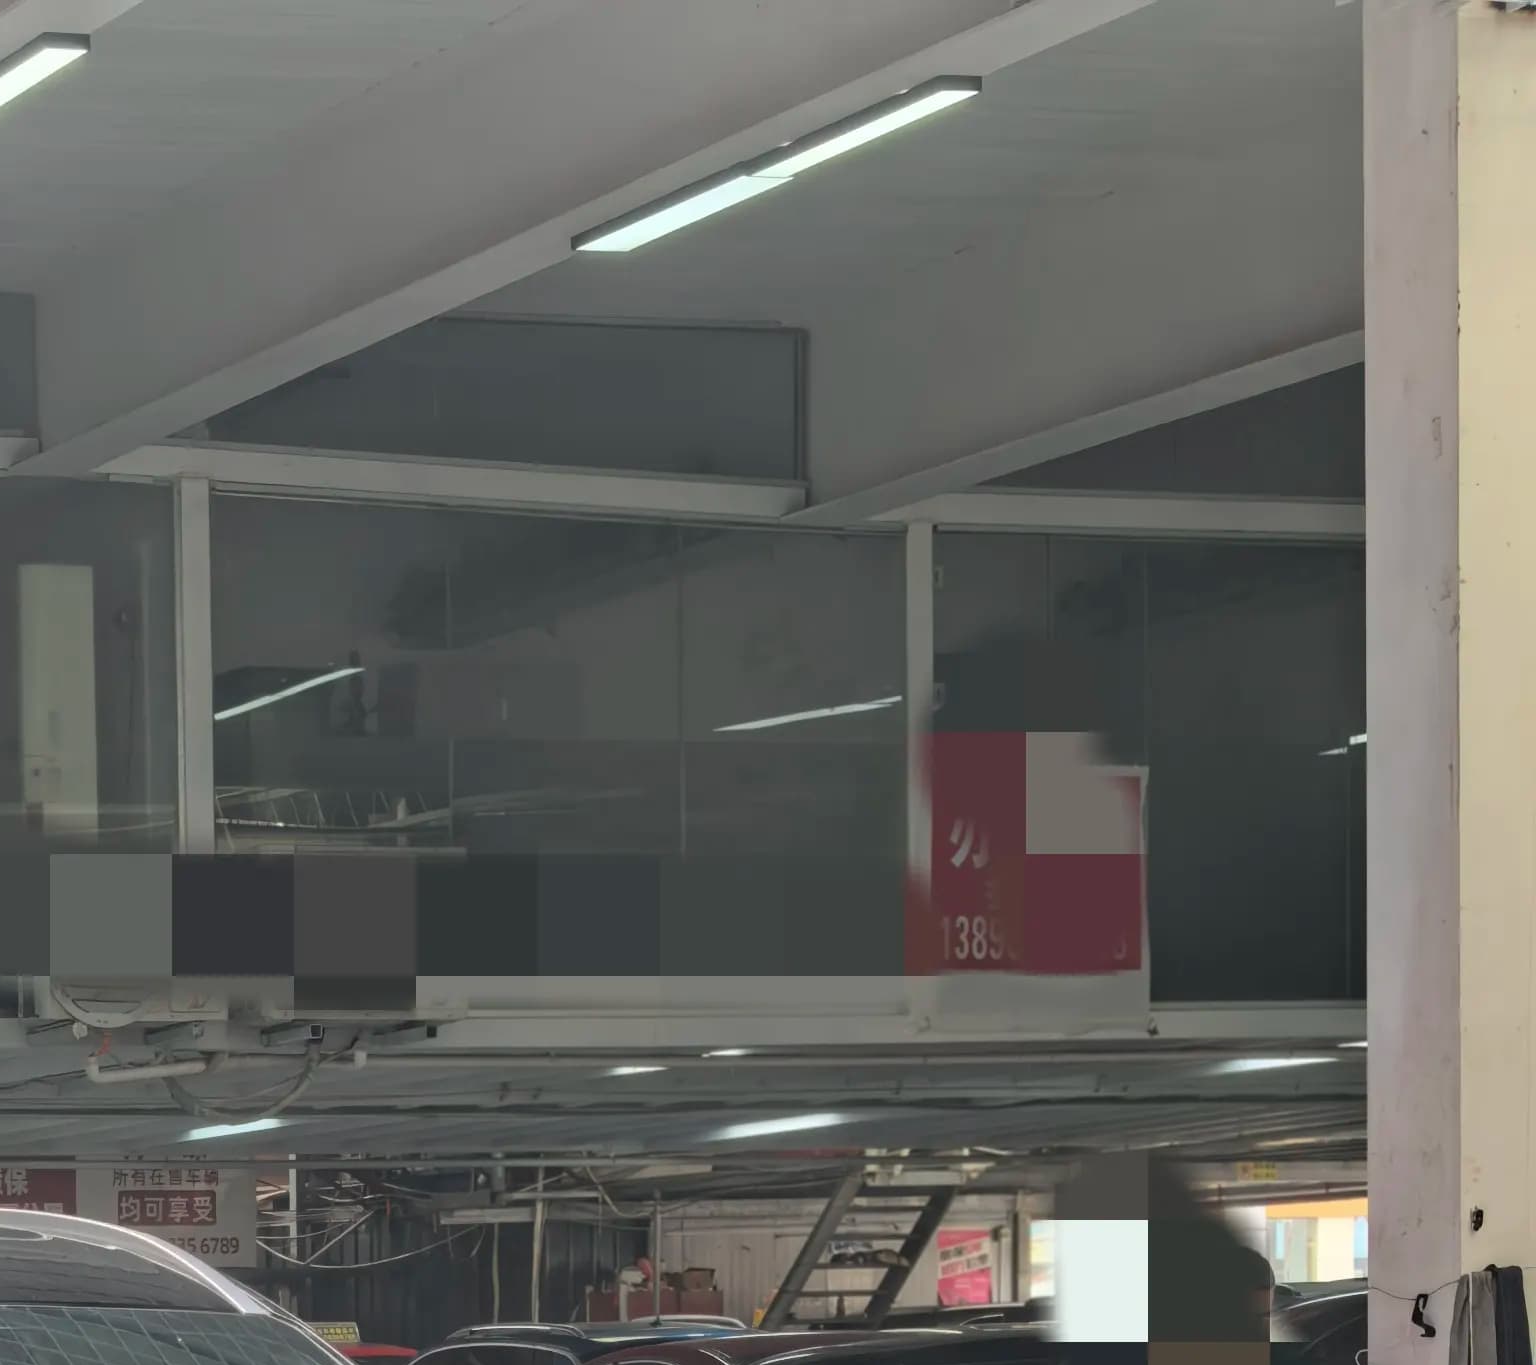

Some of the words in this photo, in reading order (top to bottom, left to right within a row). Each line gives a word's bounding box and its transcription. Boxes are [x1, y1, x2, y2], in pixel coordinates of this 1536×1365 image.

[119, 1195, 213, 1222] 均可享受
[200, 1237, 240, 1254] 6789
